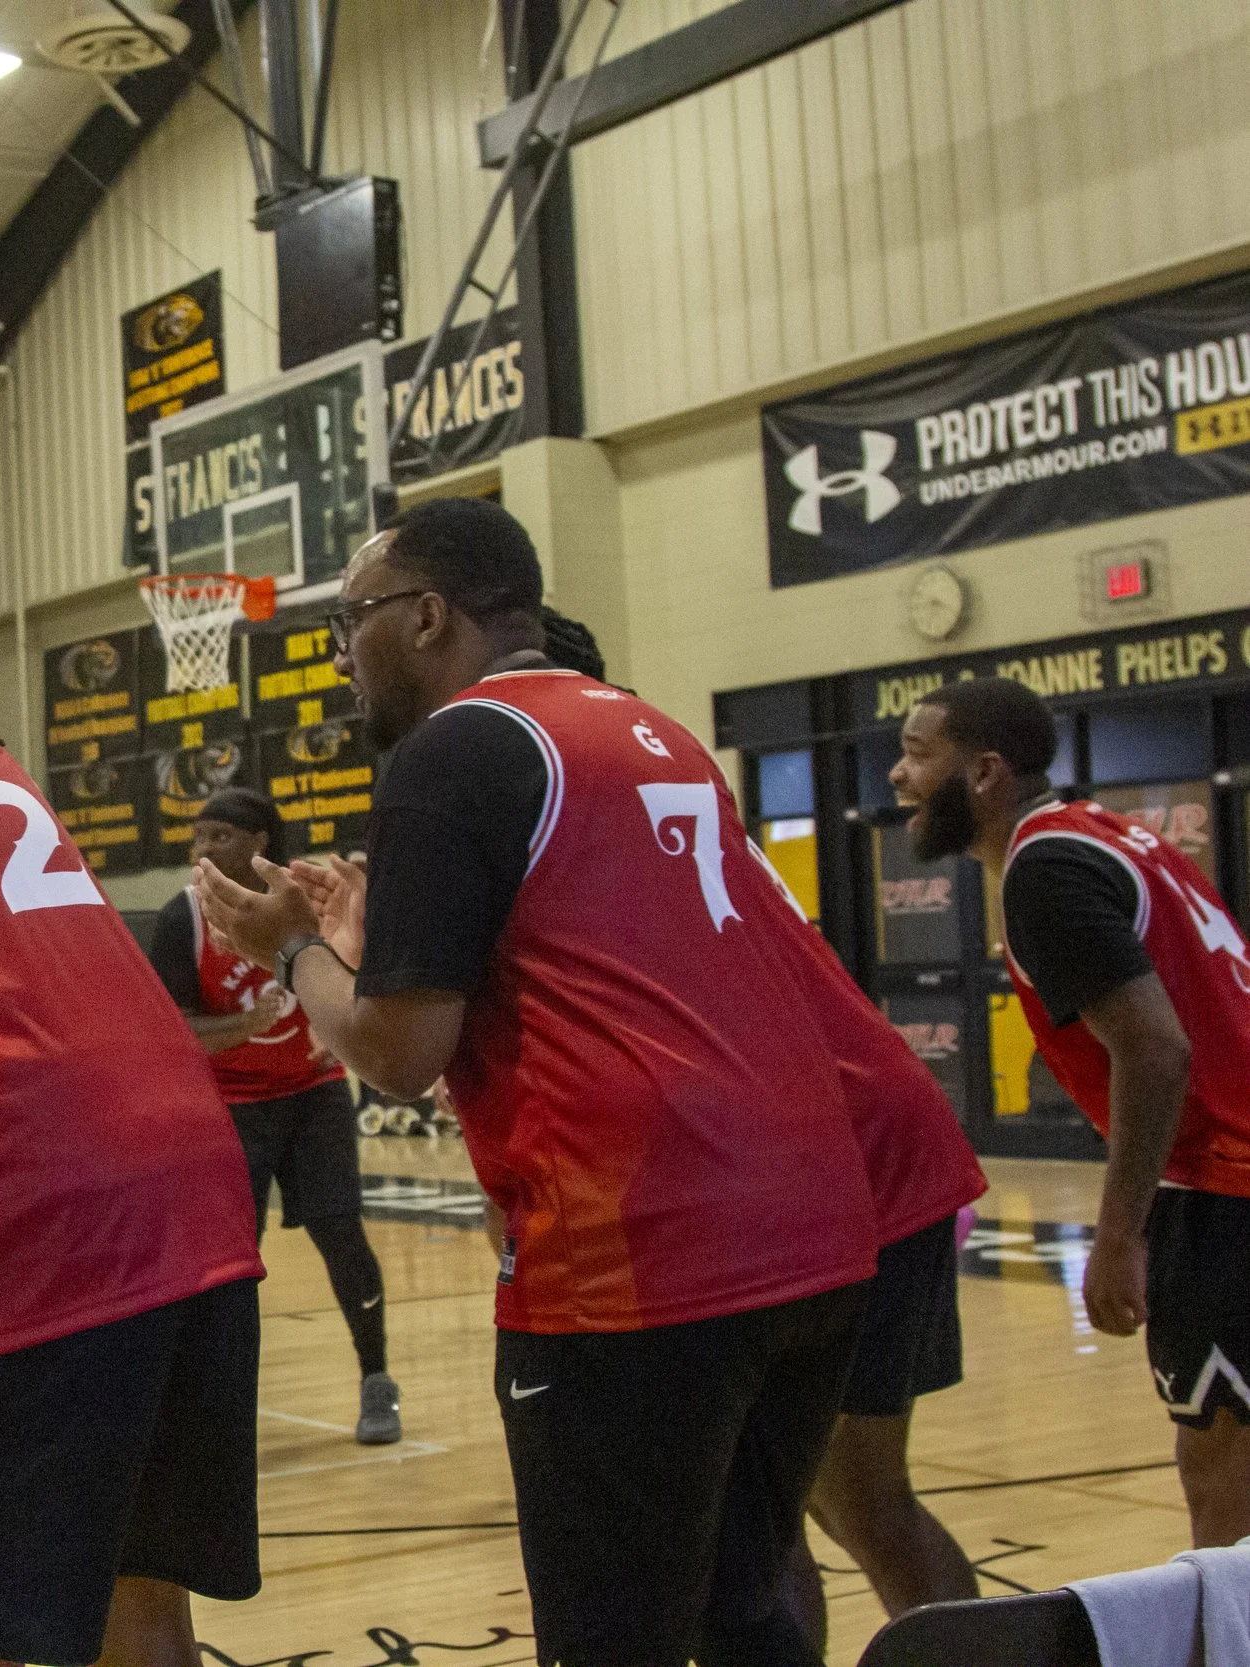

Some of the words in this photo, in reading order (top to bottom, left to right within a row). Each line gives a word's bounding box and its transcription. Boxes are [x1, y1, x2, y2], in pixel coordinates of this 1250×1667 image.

[916, 376, 1083, 472] PROTECT
[1086, 357, 1163, 428] THIS
[919, 426, 1168, 506] UNDERARMOUR.COM
[1116, 630, 1228, 686] PHELPS
[636, 778, 744, 934] 7
